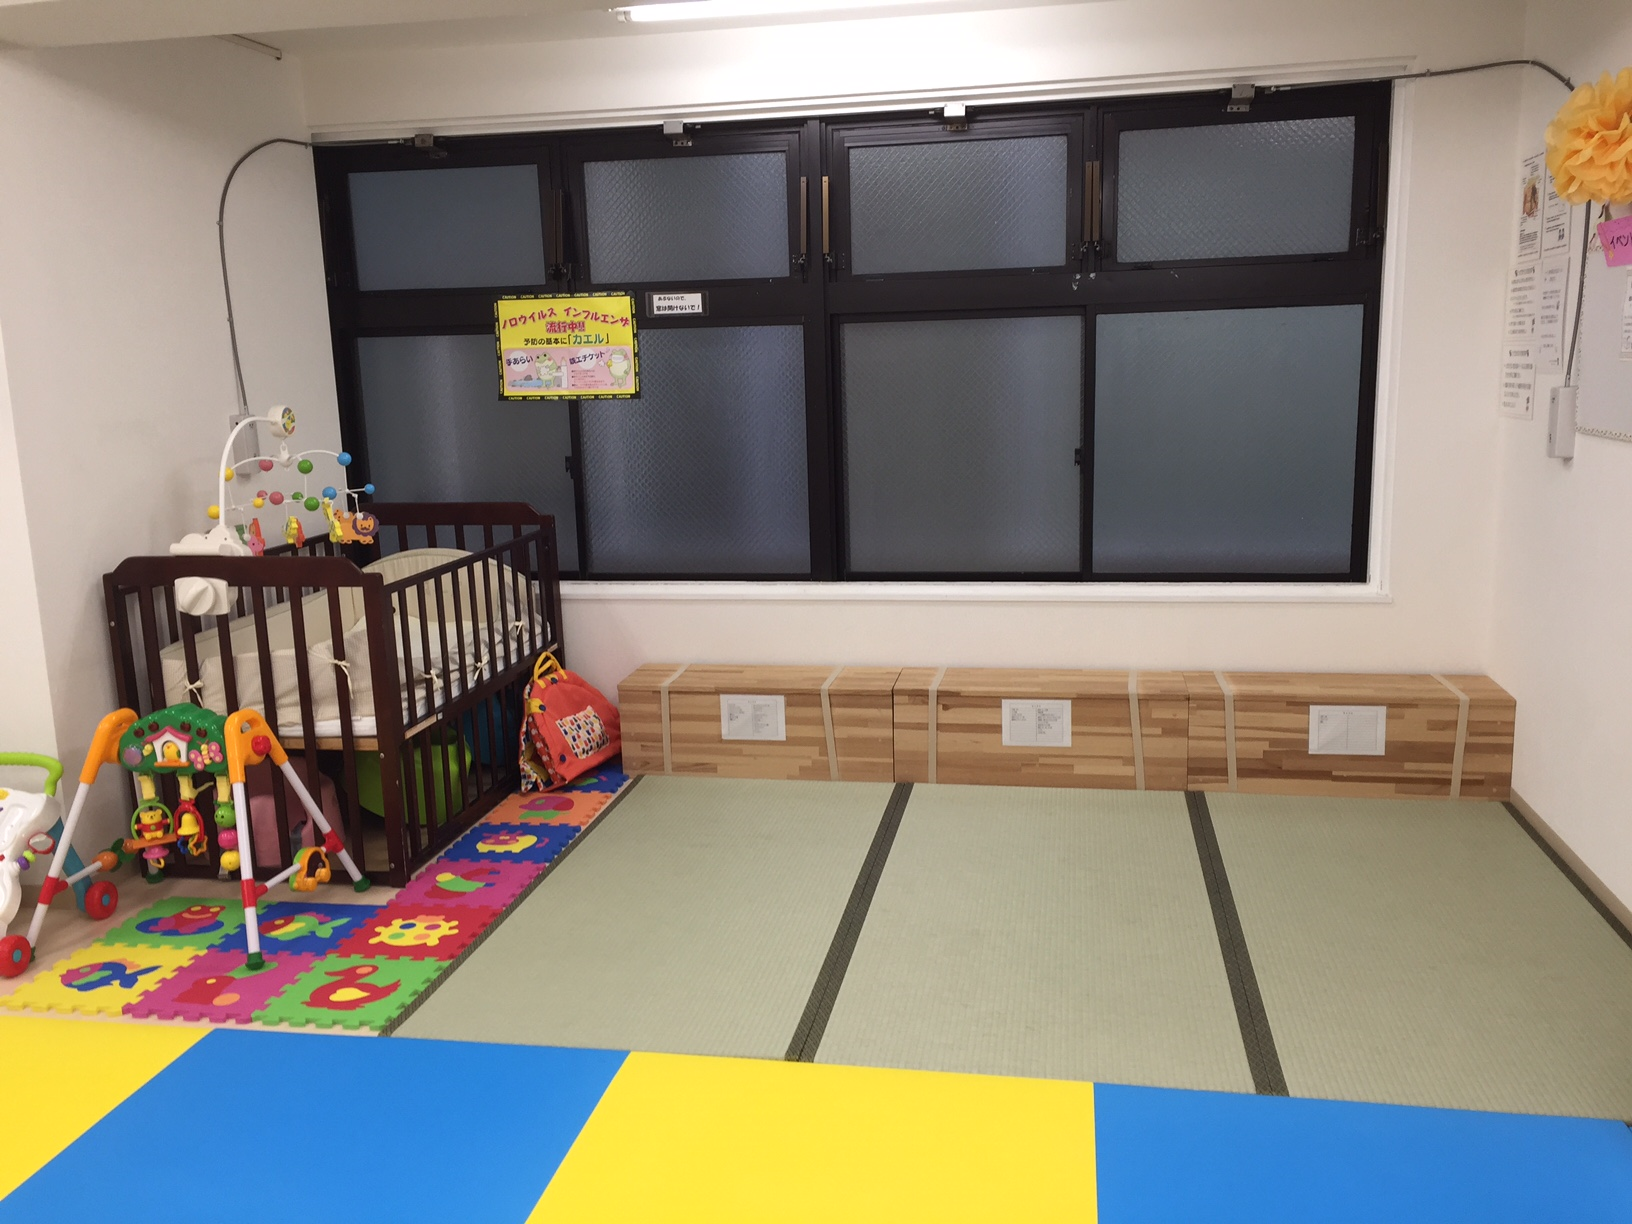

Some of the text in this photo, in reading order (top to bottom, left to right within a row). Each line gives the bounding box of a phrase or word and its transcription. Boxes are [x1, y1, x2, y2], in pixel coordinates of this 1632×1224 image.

[502, 307, 630, 329] ノロウイルス インフルエンザ
[506, 355, 533, 366] 手あらい
